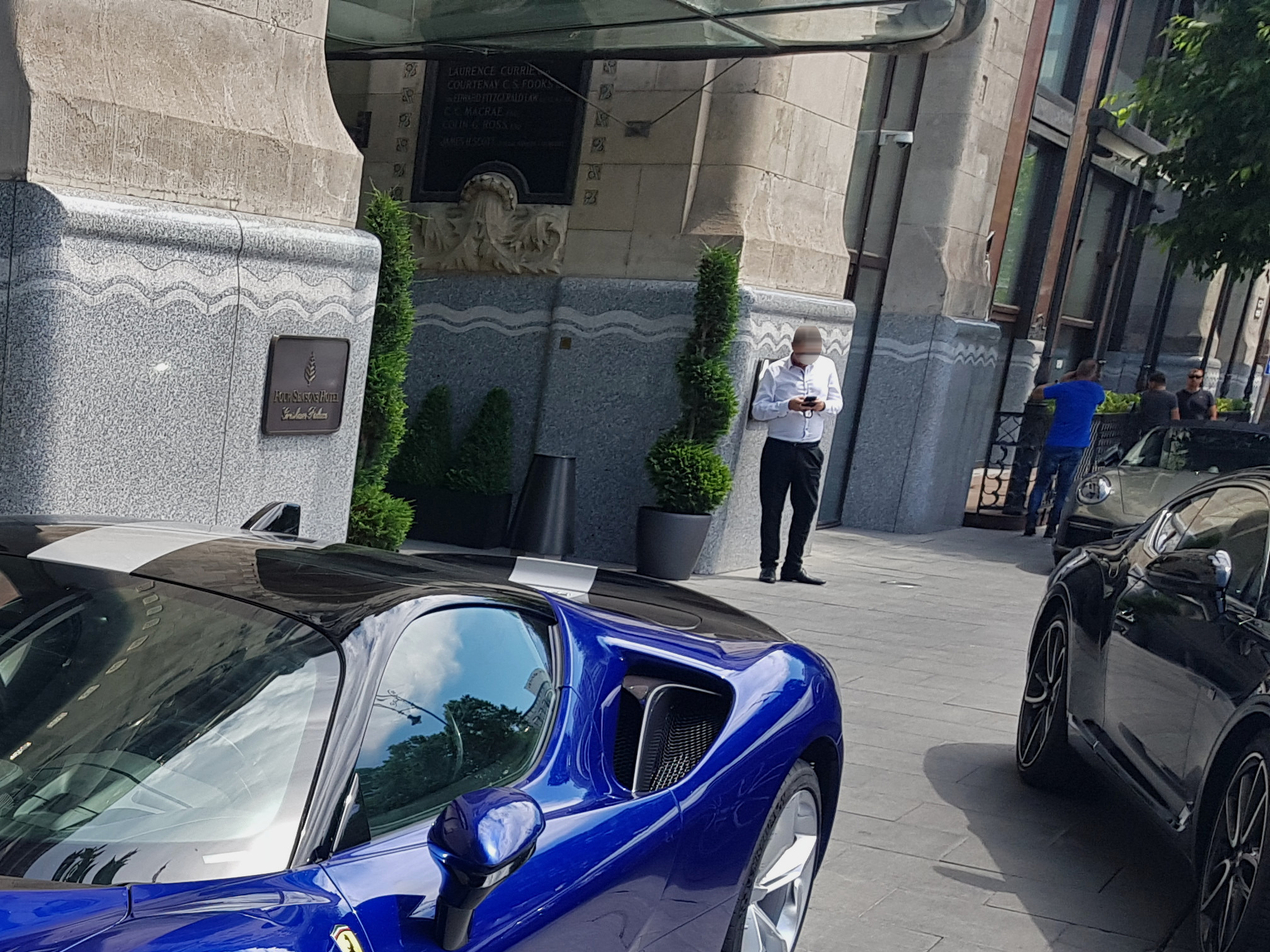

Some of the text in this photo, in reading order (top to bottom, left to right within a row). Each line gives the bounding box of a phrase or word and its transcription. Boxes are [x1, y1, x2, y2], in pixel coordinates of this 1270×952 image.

[448, 66, 495, 77] LAURENCE
[500, 65, 535, 76] CURRIE
[447, 80, 500, 90] COURTENAY
